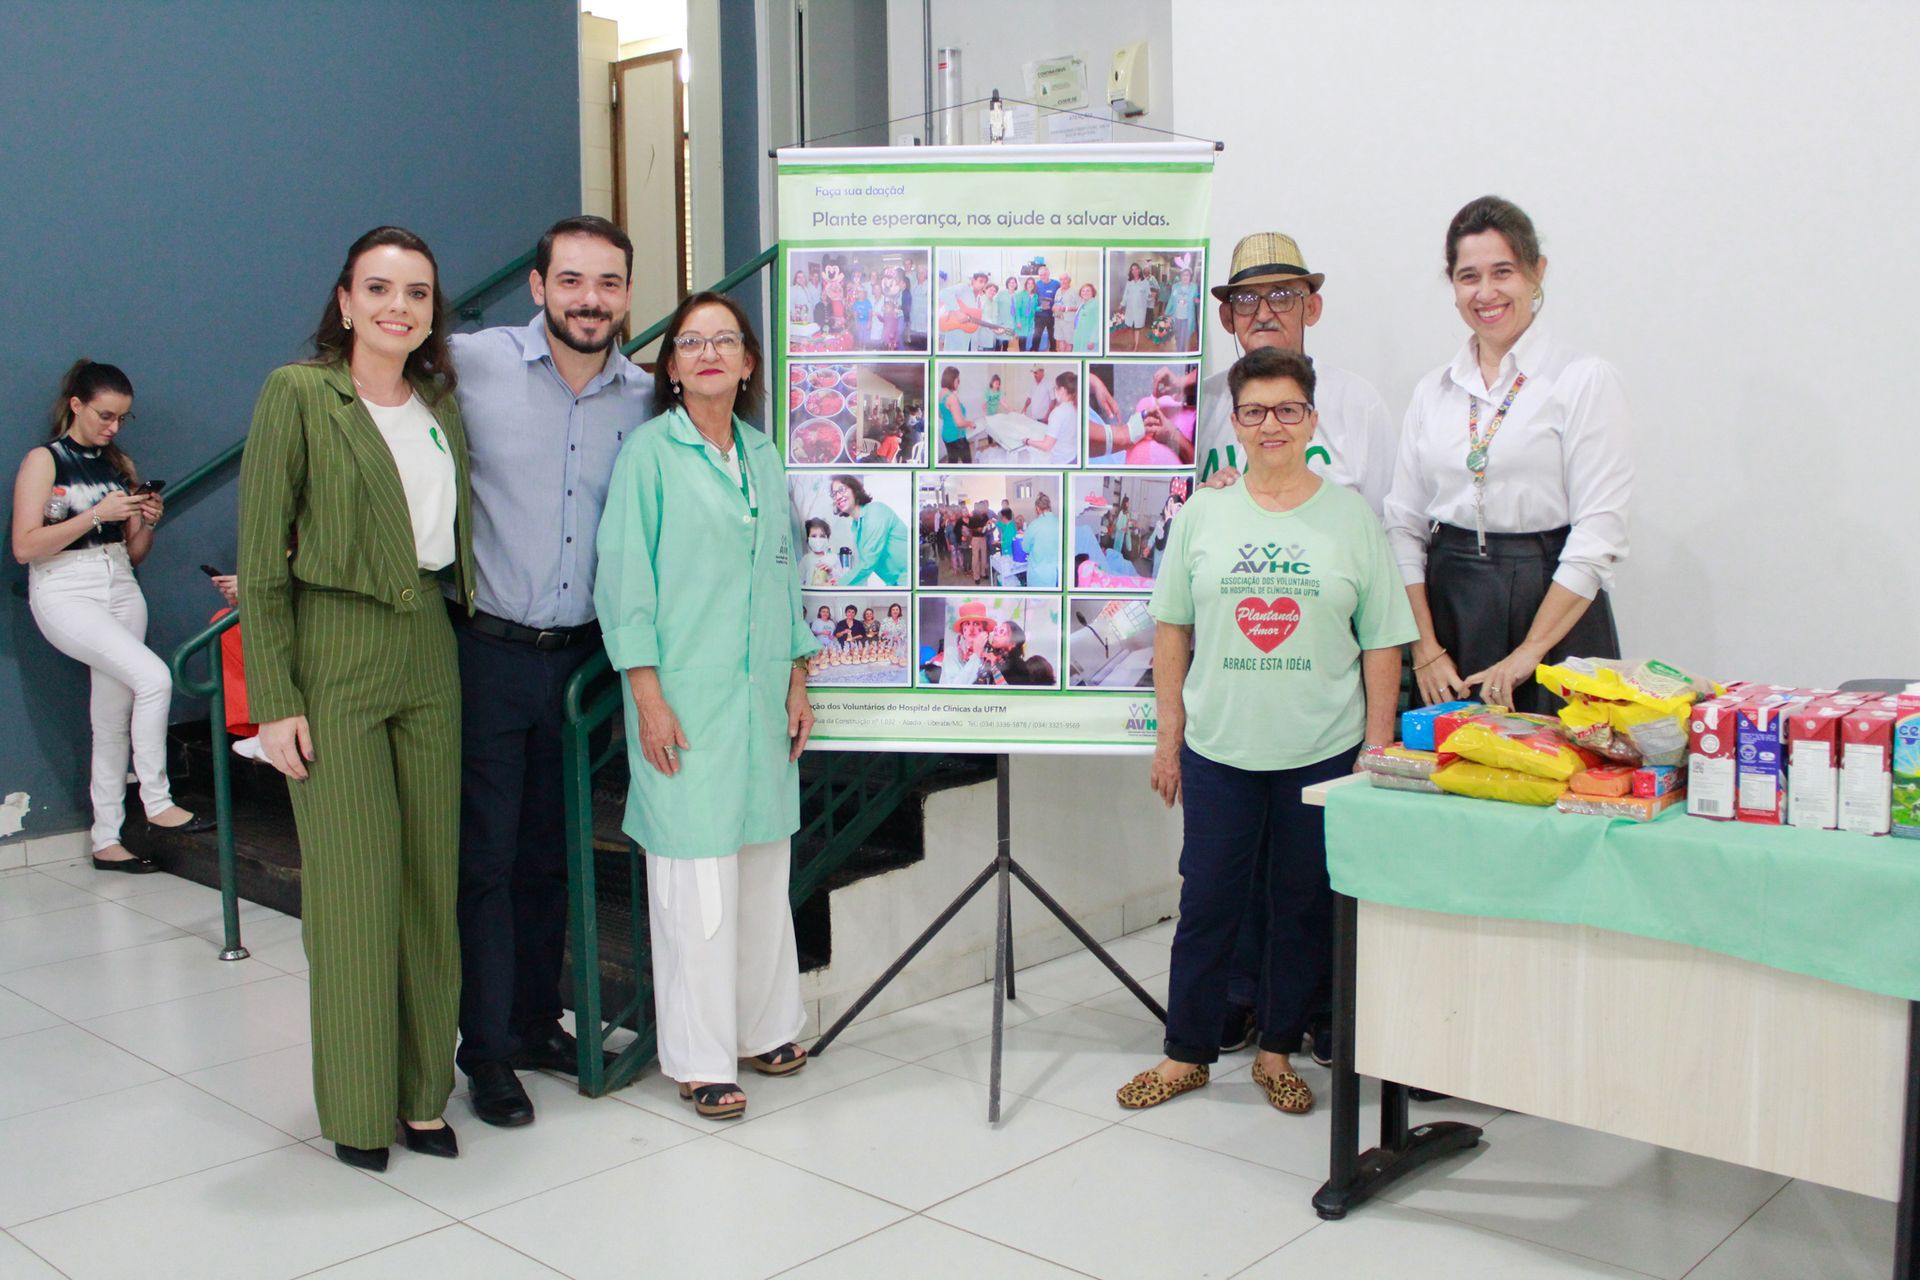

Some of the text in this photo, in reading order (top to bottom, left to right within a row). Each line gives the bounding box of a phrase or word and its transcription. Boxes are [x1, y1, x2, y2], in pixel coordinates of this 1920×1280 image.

[815, 184, 906, 198] Faça sua doação!
[812, 210, 1170, 229] Plante esperança, nos ajude a salvar vidas.
[1230, 560, 1311, 575] AVHC
[1221, 576, 1320, 588] ASSOCIAÇÃO DOS VOLUNTÁRIOS
[1220, 585, 1320, 597] DO HOSPITAL DE CLÍNICAS DA UFTM
[1237, 606, 1299, 622] Plantando
[1247, 623, 1279, 637] Amor
[1223, 655, 1312, 671] ABRACE ESTA IDÉIA
[843, 702, 886, 711] Voluntários
[886, 703, 897, 711] do
[898, 703, 930, 713] Hospital
[931, 704, 942, 712] de
[972, 705, 983, 713] da
[984, 705, 1007, 713] UFTM
